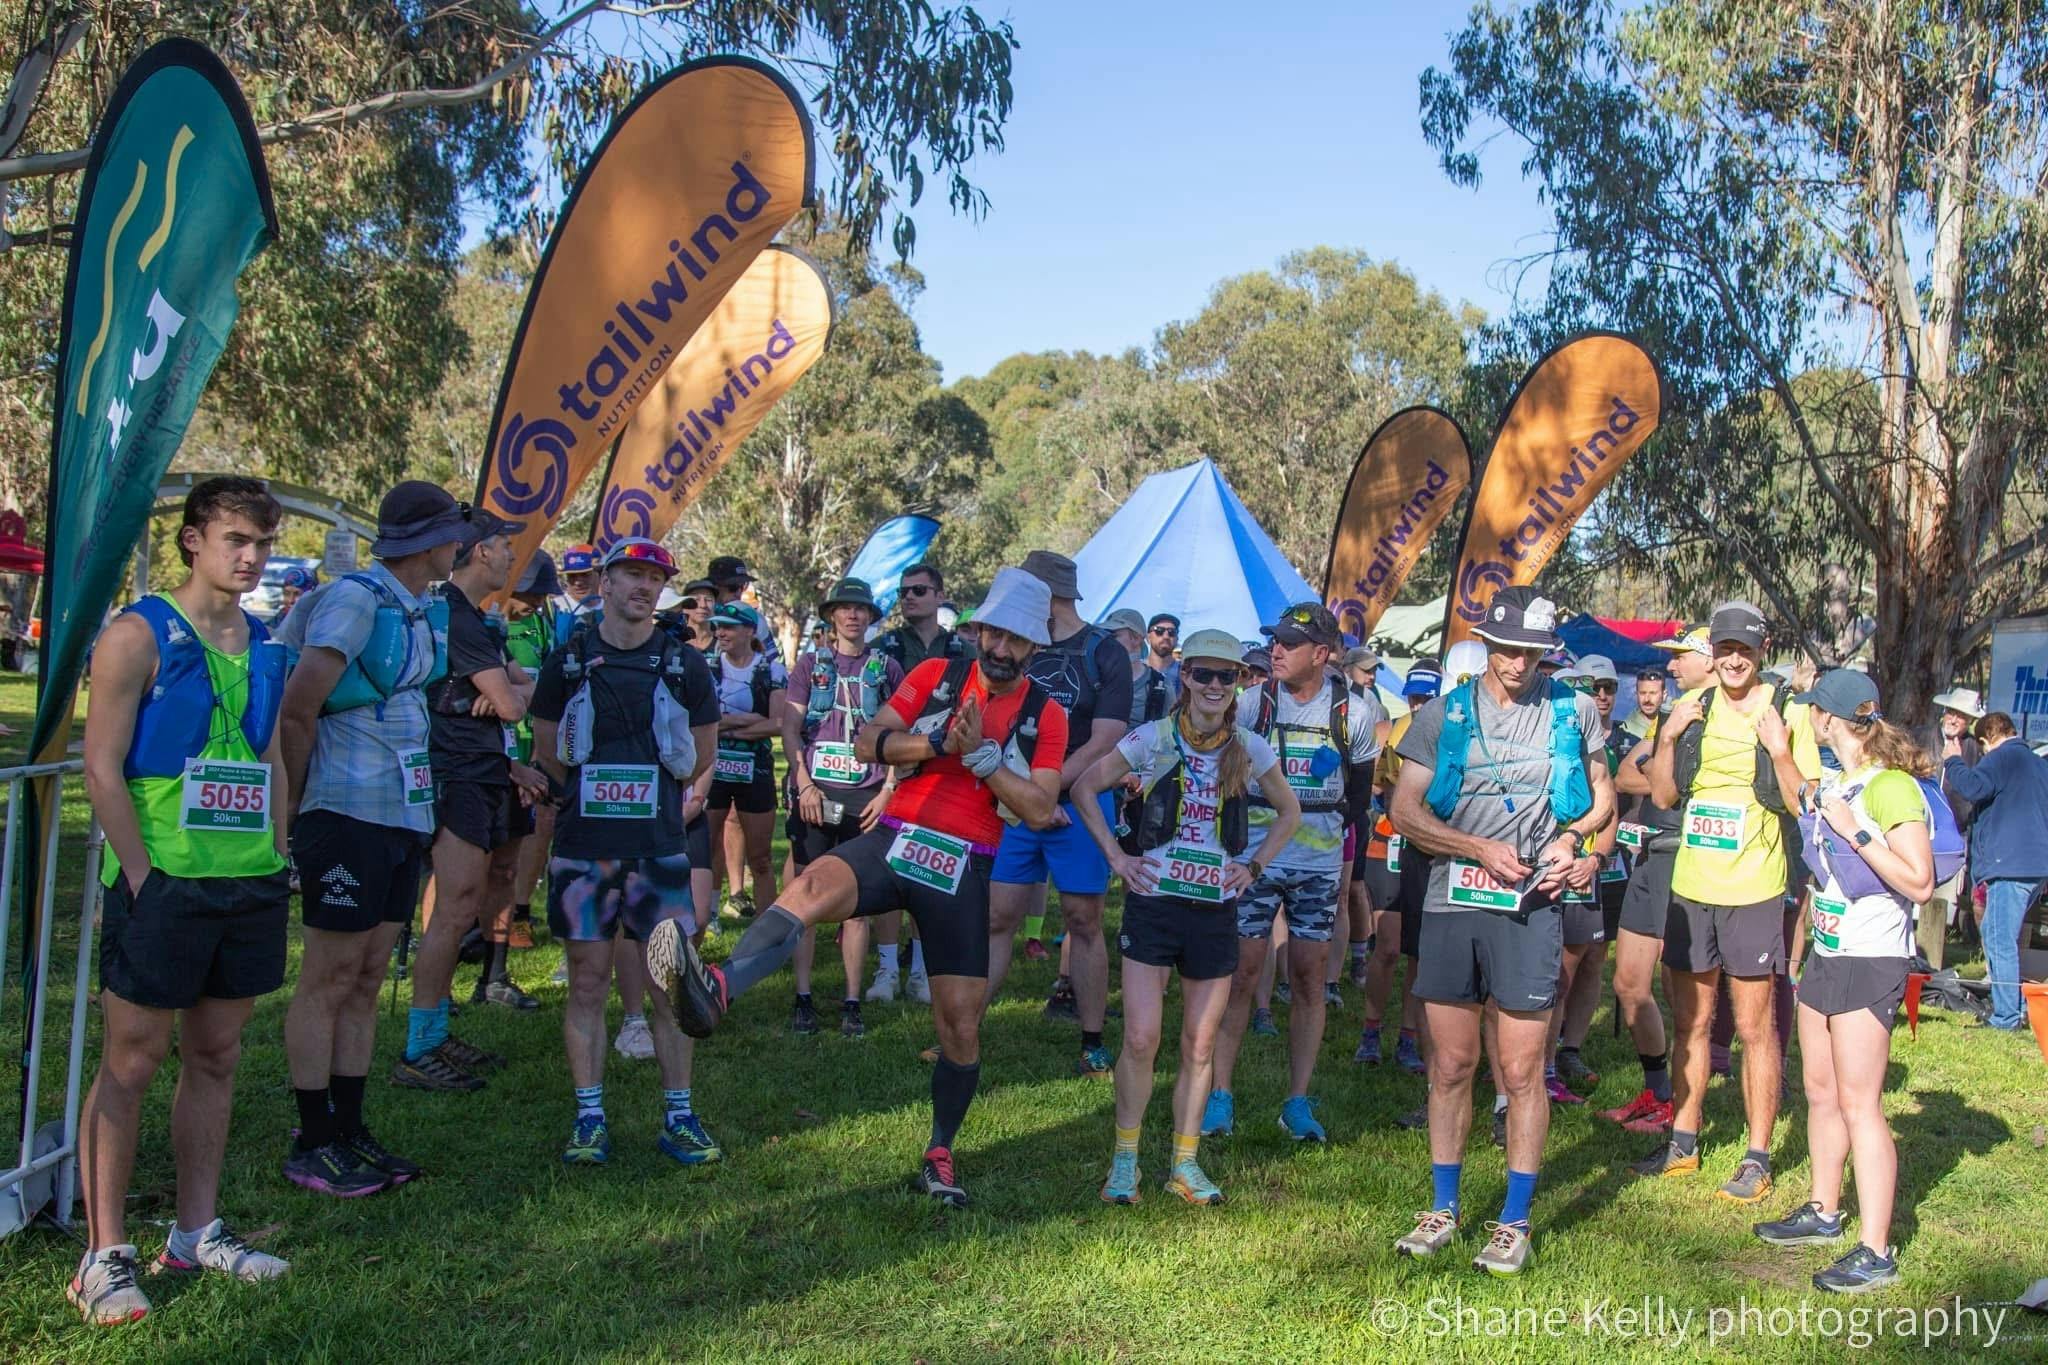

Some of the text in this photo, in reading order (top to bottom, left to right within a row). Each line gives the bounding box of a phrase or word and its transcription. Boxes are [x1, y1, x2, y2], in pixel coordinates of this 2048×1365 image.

[558, 159, 772, 421] tailwind
[597, 343, 672, 438] NUTRITION
[644, 318, 797, 492] tailwind
[672, 439, 726, 504] NUTRITION
[1500, 395, 1641, 561] tailwind
[1354, 458, 1450, 600] tailwind
[1528, 510, 1577, 572] NUTRITION
[566, 712, 577, 763] SALOMON
[200, 782, 264, 811] 5055
[594, 782, 651, 802] 5047
[213, 812, 241, 824] 50km
[606, 804, 631, 813] 50km
[1692, 816, 1737, 838] 5033
[1699, 836, 1720, 847] 50km
[901, 840, 957, 876] 5068
[908, 864, 933, 881] 50km
[1169, 860, 1221, 887] 5026
[1178, 883, 1203, 895] 50km
[1470, 891, 1494, 903] 50km
